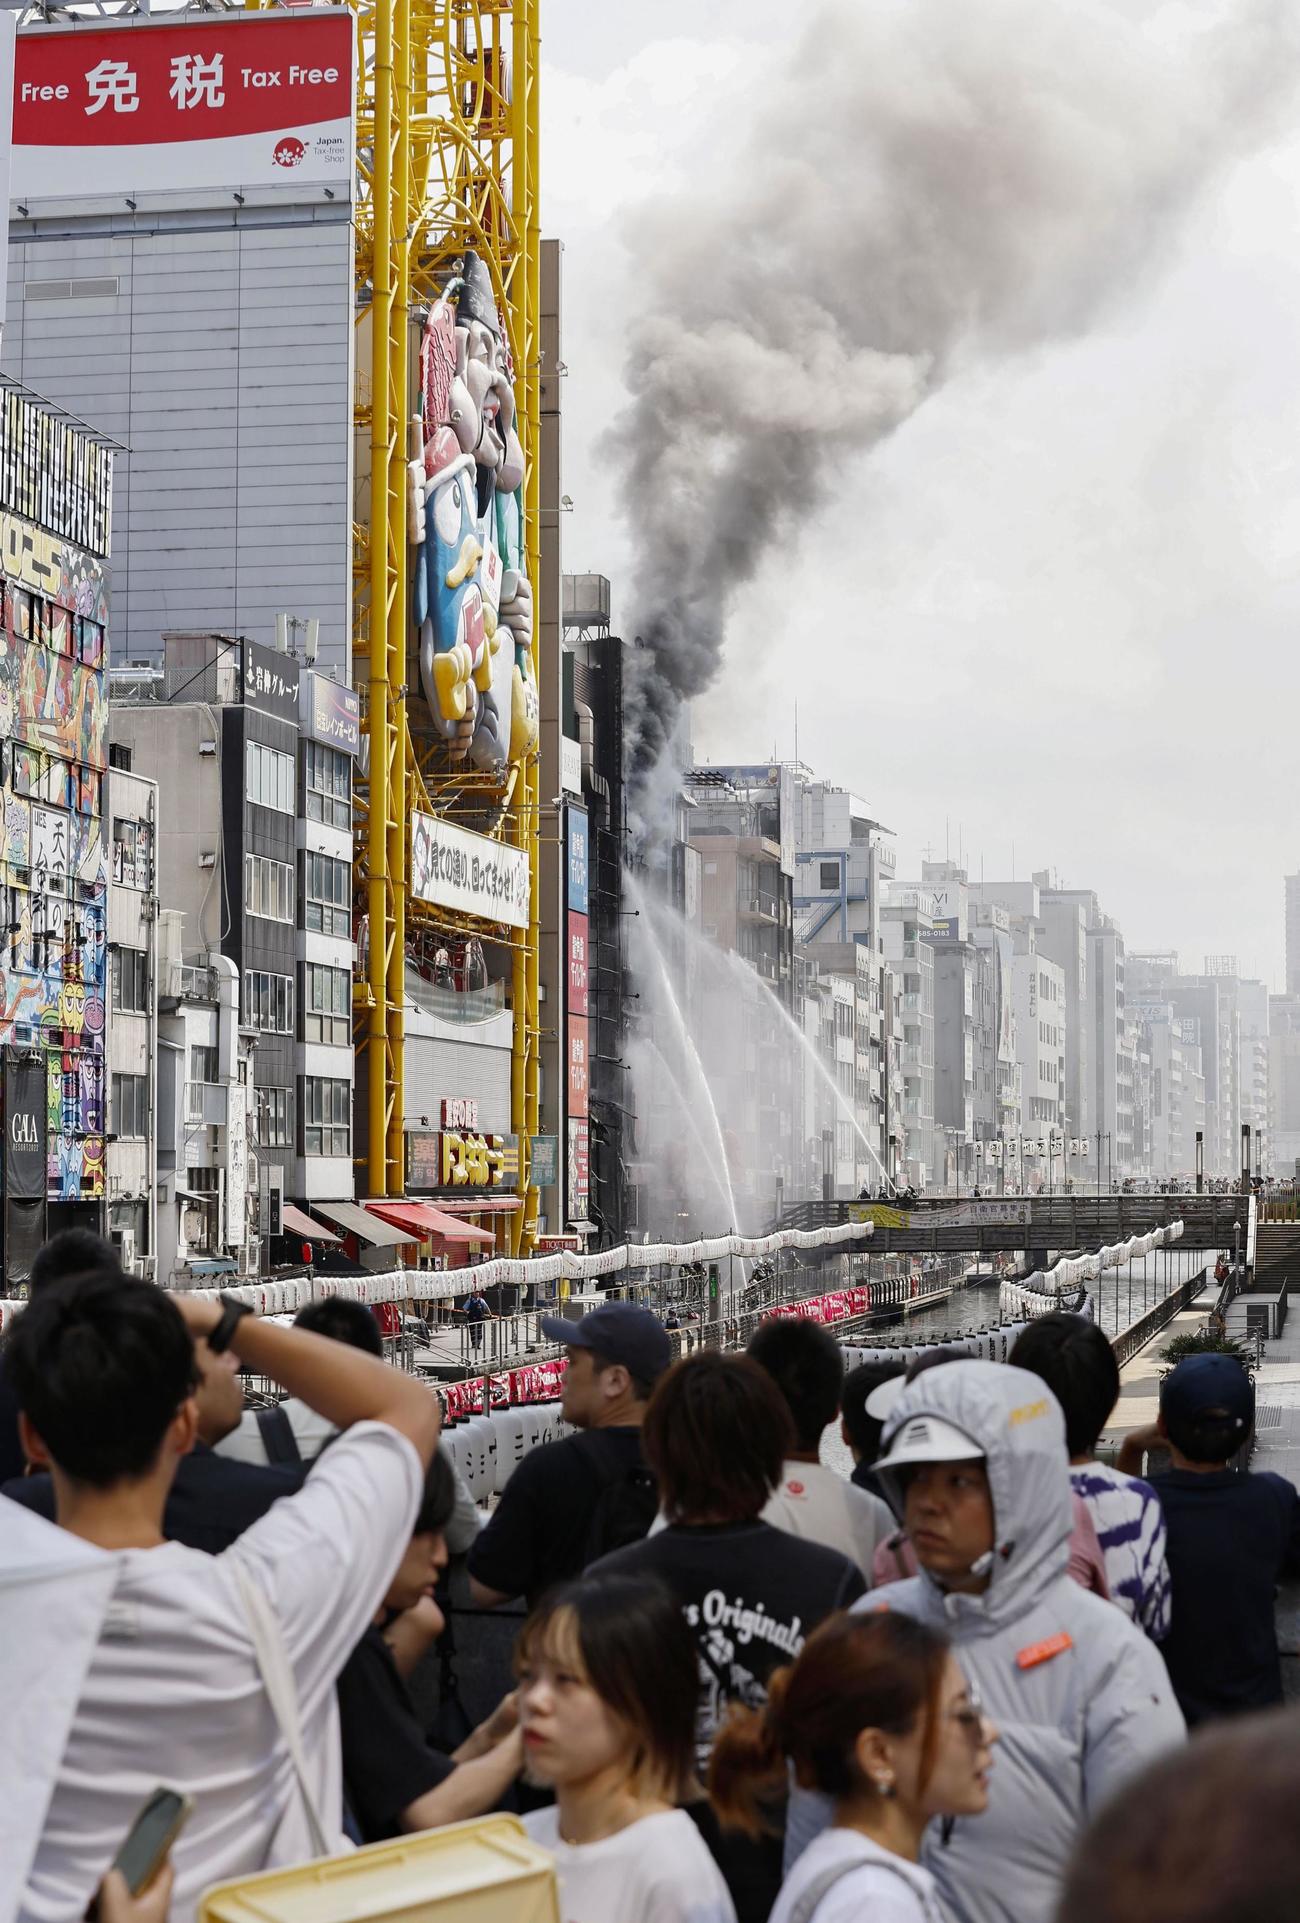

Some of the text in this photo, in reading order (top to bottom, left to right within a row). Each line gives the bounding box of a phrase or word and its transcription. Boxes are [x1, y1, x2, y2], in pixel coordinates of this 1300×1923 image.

[21, 53, 339, 116] Free 免税 Tax Free
[313, 147, 345, 155] Tax-free
[316, 136, 345, 146] Japan.
[324, 155, 345, 163] Shop
[12, 1113, 39, 1143] GALA
[703, 1589, 806, 1658] Originals
